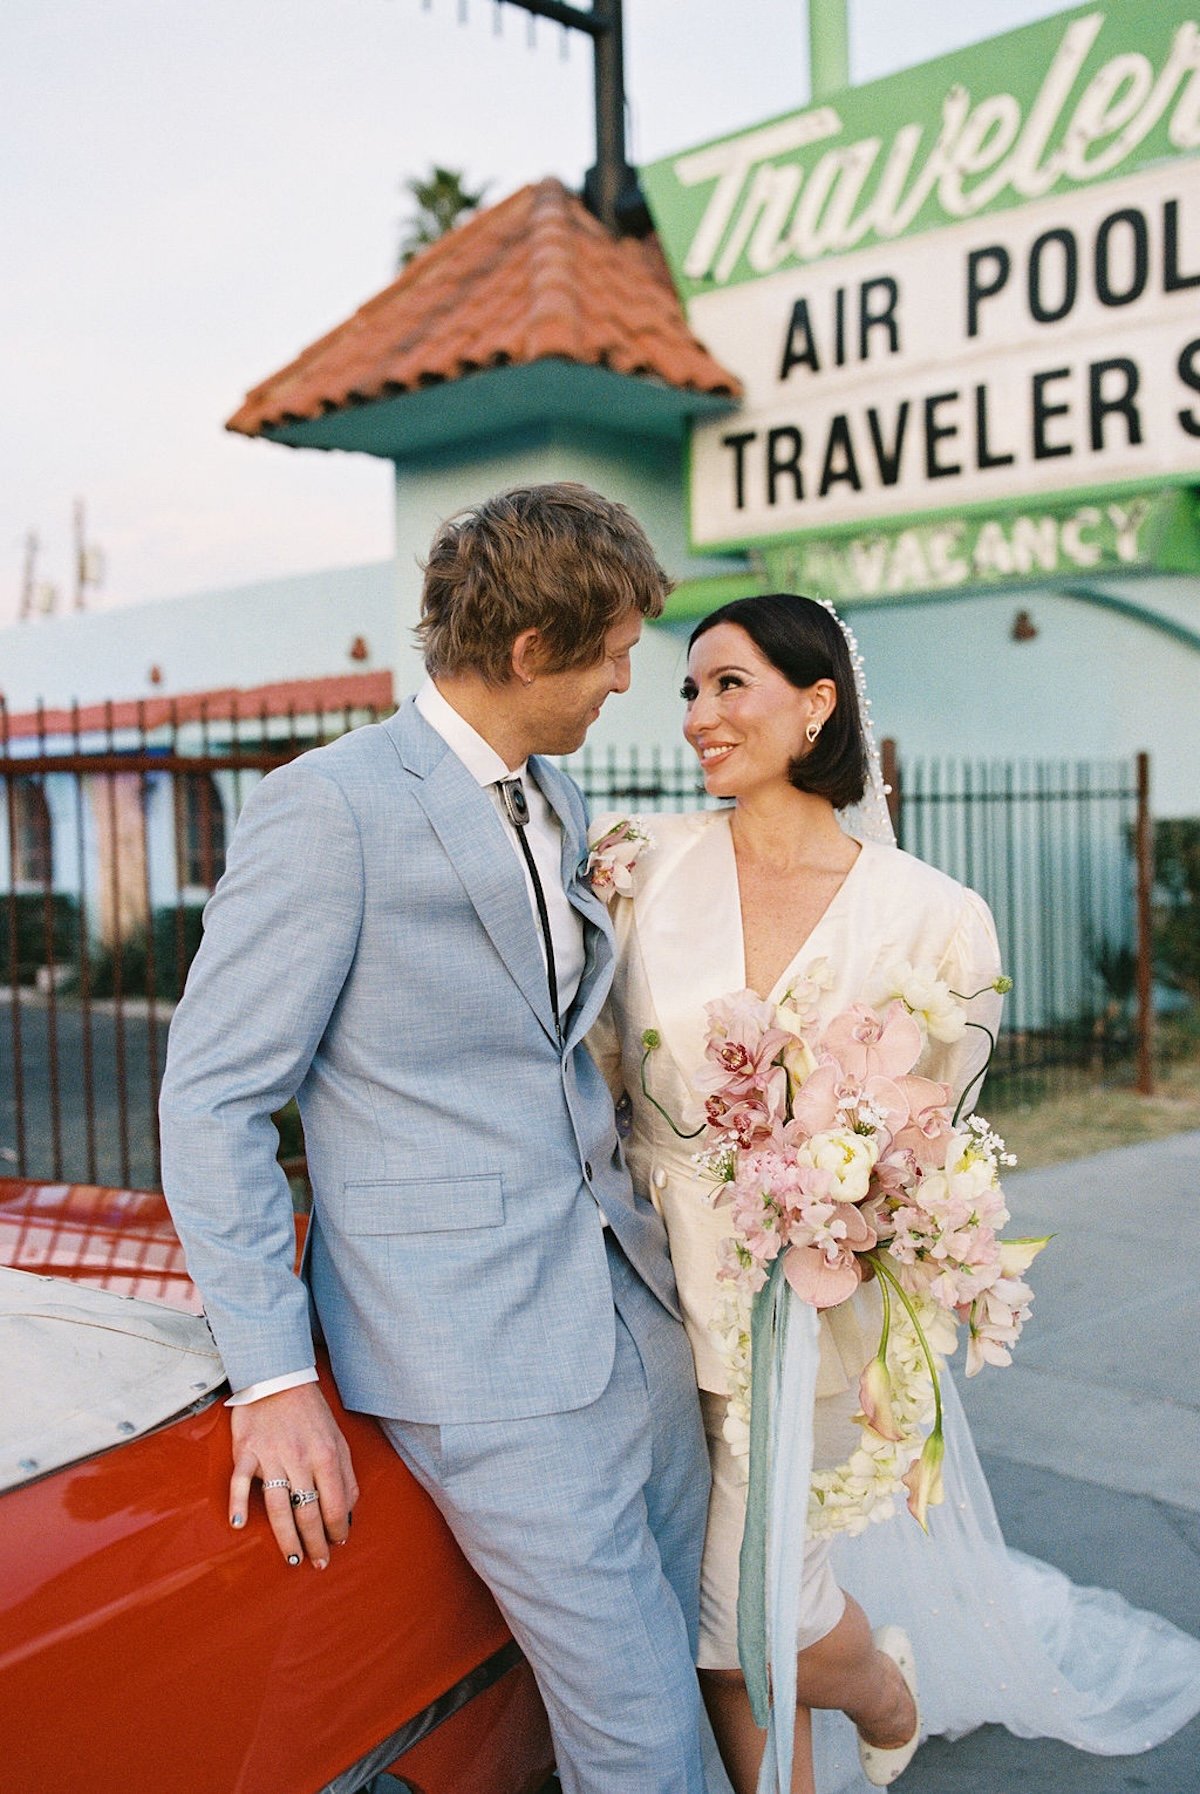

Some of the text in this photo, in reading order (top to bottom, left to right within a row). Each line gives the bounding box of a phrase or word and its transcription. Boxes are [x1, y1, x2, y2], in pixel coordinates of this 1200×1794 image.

[781, 200, 1200, 380] AIR POOL
[850, 502, 1148, 596] VACANCY
